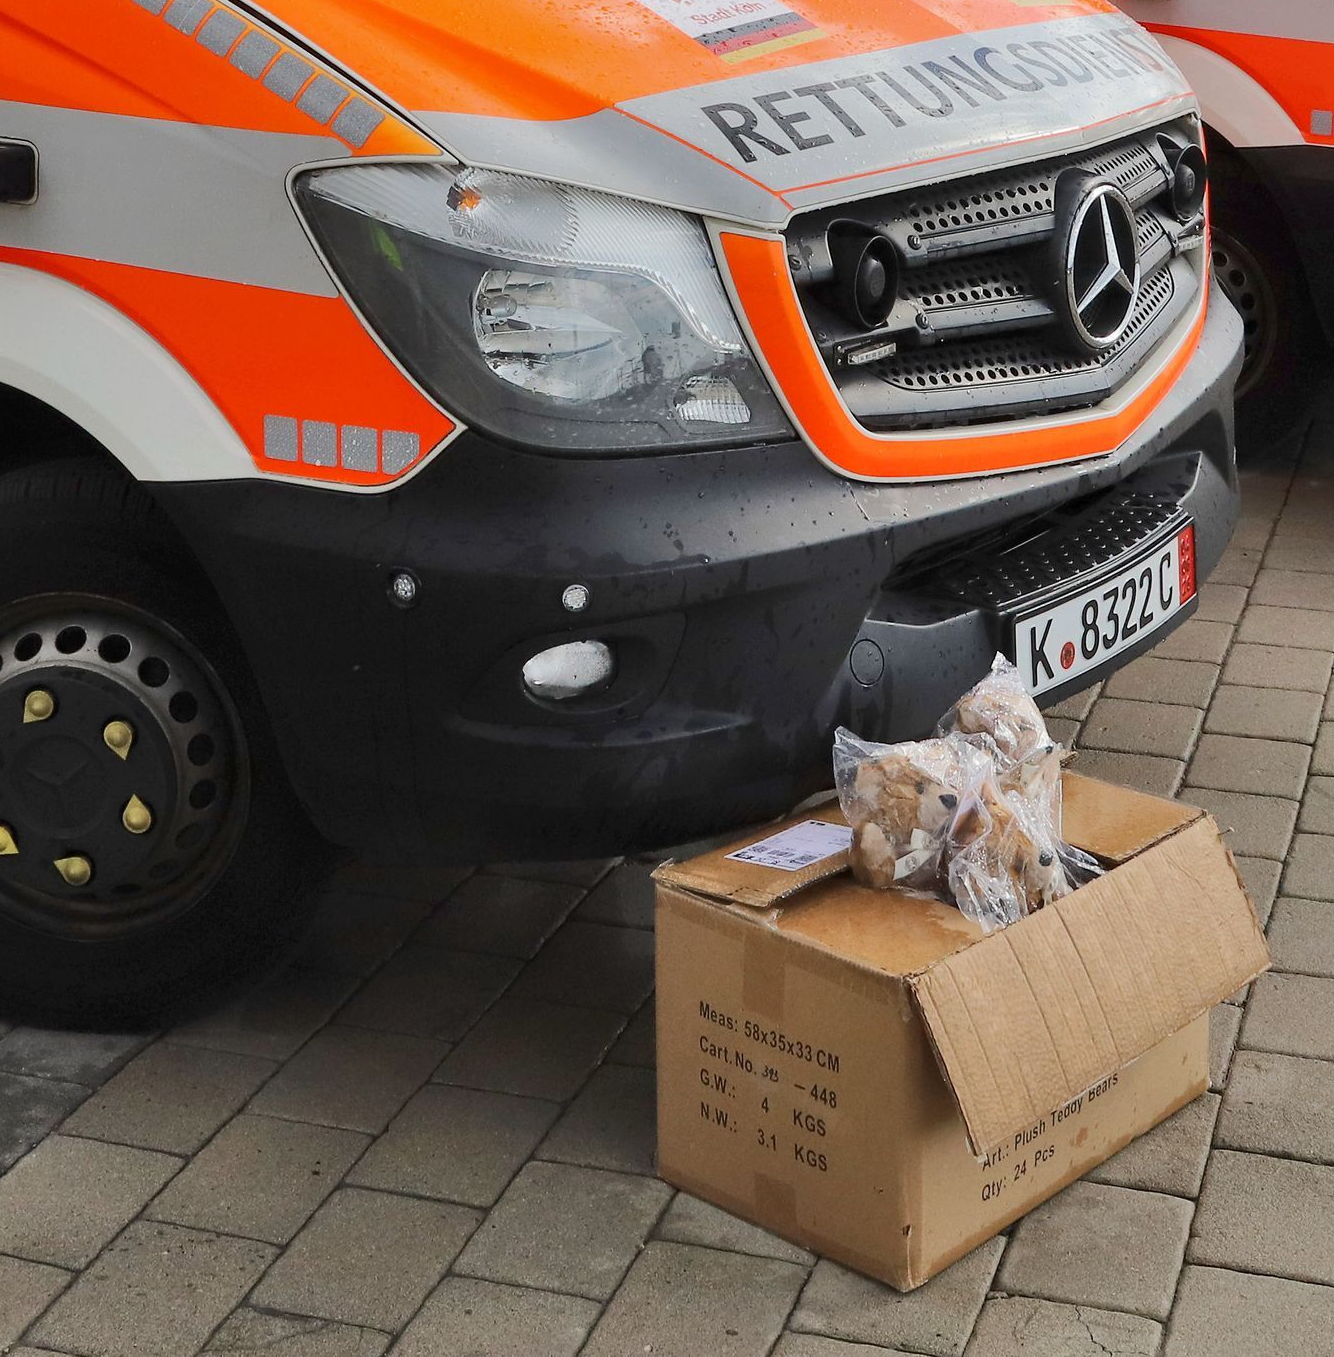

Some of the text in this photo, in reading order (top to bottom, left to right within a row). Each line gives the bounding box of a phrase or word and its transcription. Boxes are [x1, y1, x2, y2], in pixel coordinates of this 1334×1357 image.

[691, 1, 767, 25] Stadt Köln
[1030, 618, 1055, 688] K
[699, 1000, 840, 1074] Meas: 58x35x33 CM
[700, 1068, 827, 1138] G.W.: 4 KGS
[810, 1084, 837, 1109] 448
[1014, 1119, 1046, 1152] Plush
[1050, 1097, 1084, 1127] Teddy
[1088, 1072, 1119, 1103] Bears
[700, 1101, 828, 1172] N.W.: 3.1 KGS
[981, 1144, 1056, 1202] Qty: 24 Pcs
